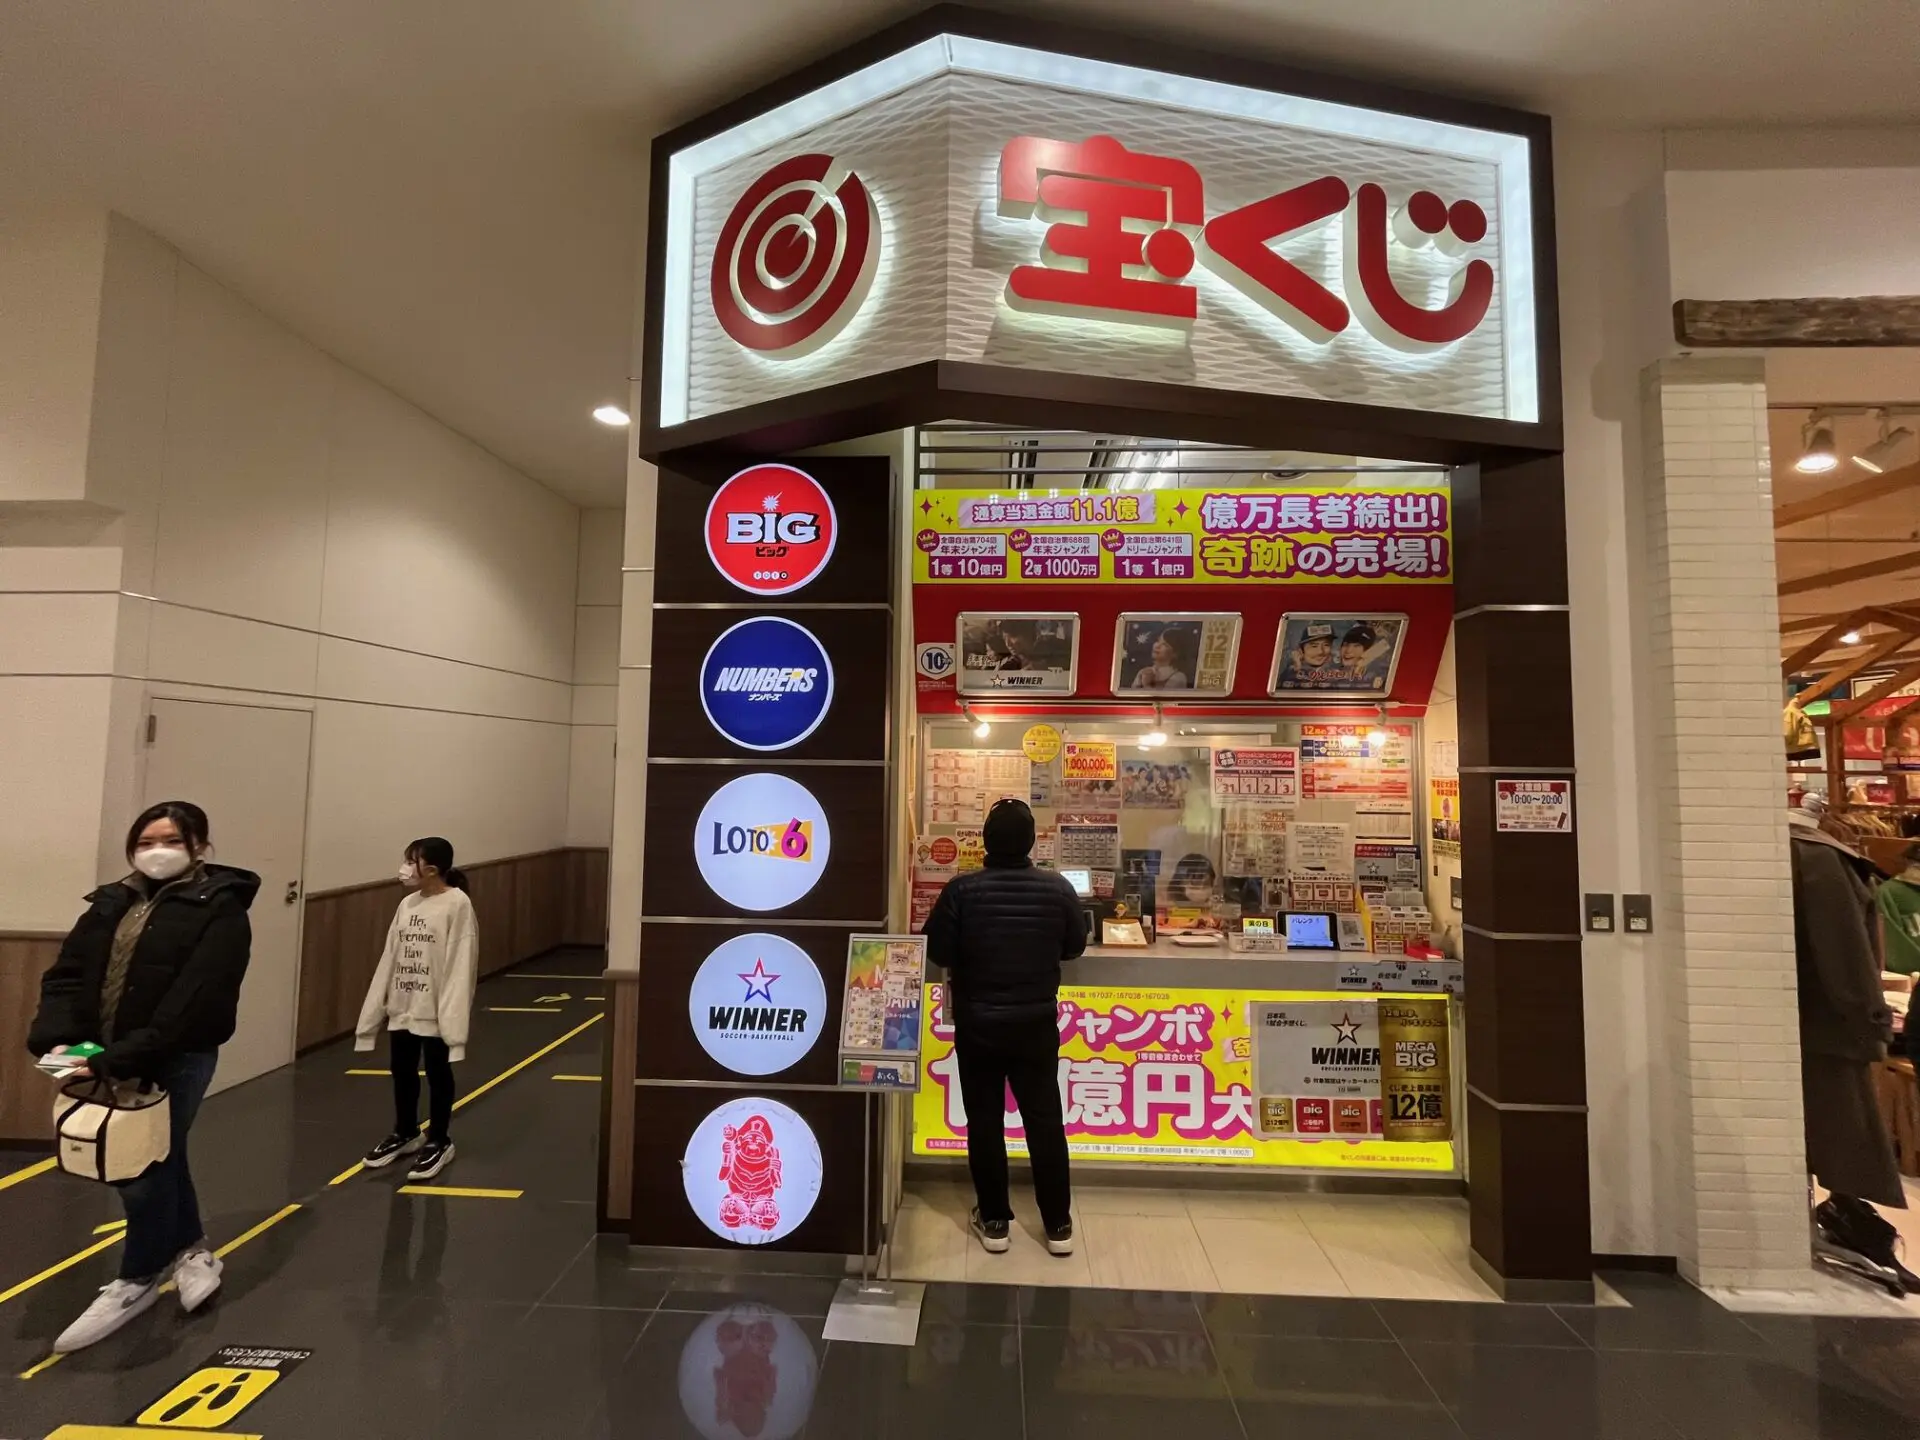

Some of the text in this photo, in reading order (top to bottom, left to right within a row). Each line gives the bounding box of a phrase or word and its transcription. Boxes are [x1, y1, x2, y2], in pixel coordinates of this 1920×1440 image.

[996, 134, 1494, 346] 宝くじ
[1201, 495, 1441, 530] 億万長者続出!
[725, 510, 821, 545] BIG
[755, 546, 789, 557] ビッグ
[940, 545, 998, 555] 年末ジャンボ
[1032, 545, 1090, 555] 年末ジャンボ
[1126, 545, 1183, 555] ドリームジャンボ
[1202, 537, 1442, 574] 奇跡の売場!
[958, 558, 1003, 576] 10億円
[1045, 558, 1097, 576] 1000万円
[1151, 558, 1185, 576] 1億円
[714, 667, 818, 692] NUMBERS
[1007, 677, 1044, 685] WINNER
[748, 693, 783, 702] ナンバーズ
[408, 914, 427, 929] Hey,
[709, 1006, 808, 1032] WINNER
[1395, 1041, 1436, 1052] MEGA
[1311, 1047, 1381, 1065] WINNER
[1395, 1052, 1436, 1067] BIG
[1388, 1093, 1443, 1120] 12億
